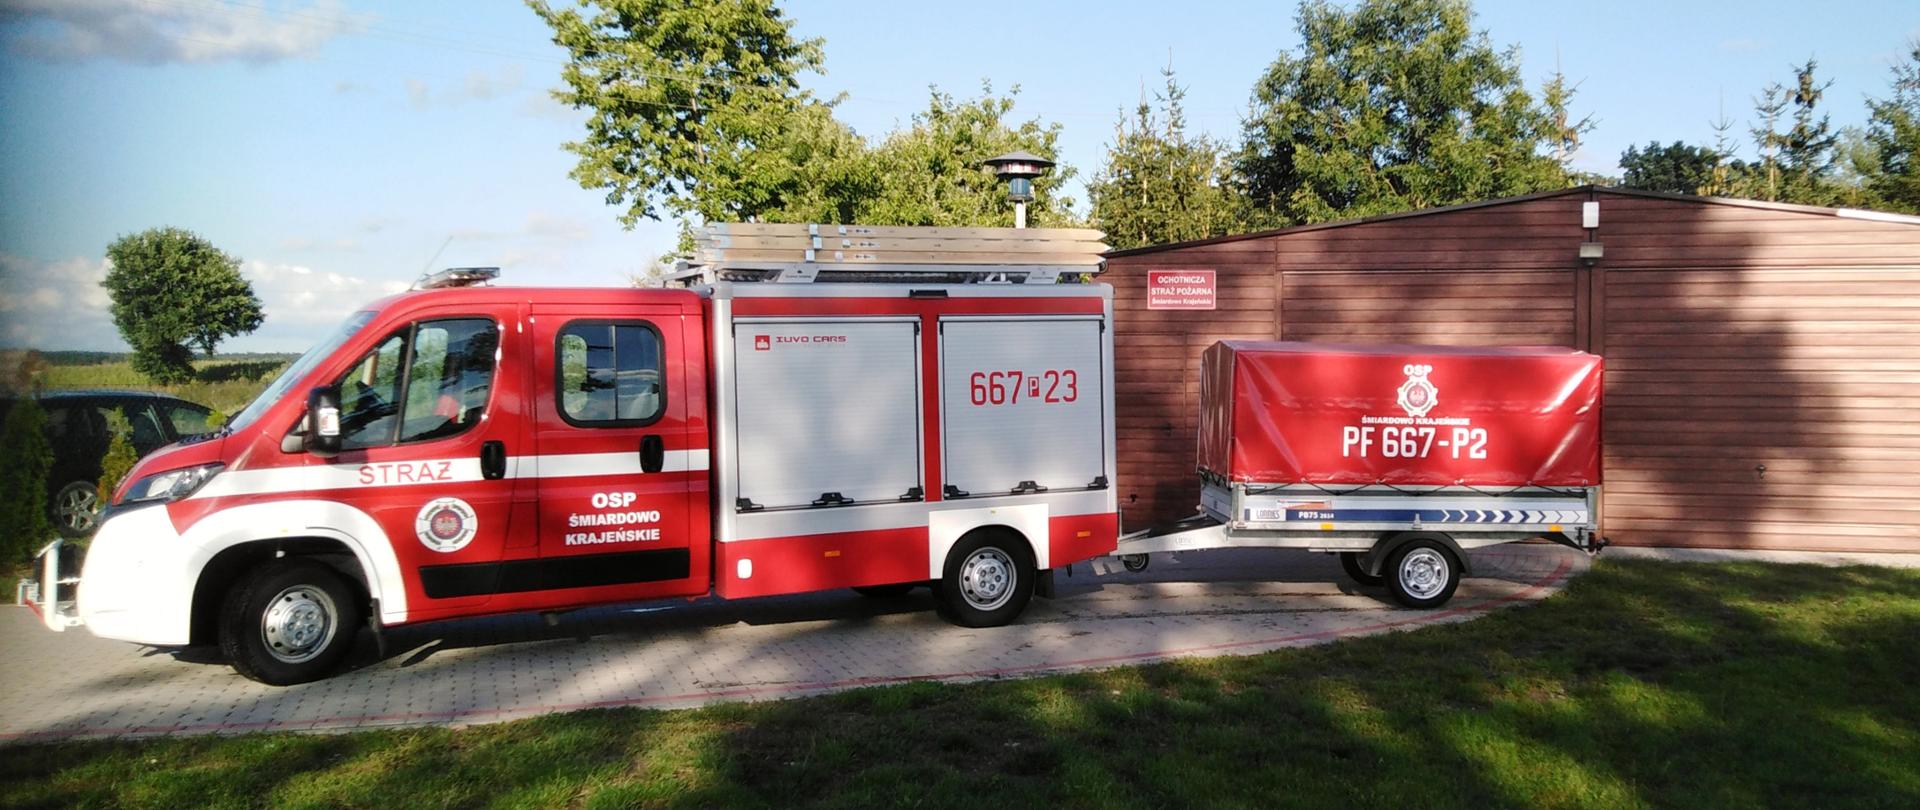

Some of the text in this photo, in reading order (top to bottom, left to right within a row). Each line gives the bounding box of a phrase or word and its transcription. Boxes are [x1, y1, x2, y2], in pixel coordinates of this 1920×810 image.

[1158, 275, 1206, 284] OCHOTNICZA
[1151, 286, 1213, 296] STRAŻ POŻARNA
[1403, 364, 1433, 376] OSP
[970, 371, 1023, 406] 667
[1044, 370, 1078, 403] 23
[1361, 415, 1414, 424] ŚMIARDOWO
[1343, 426, 1488, 459] PF 667-P2
[592, 492, 637, 509] OSP
[568, 510, 661, 528] ŚMIARDOWO
[565, 527, 661, 546] KRAJEŃSKIE
